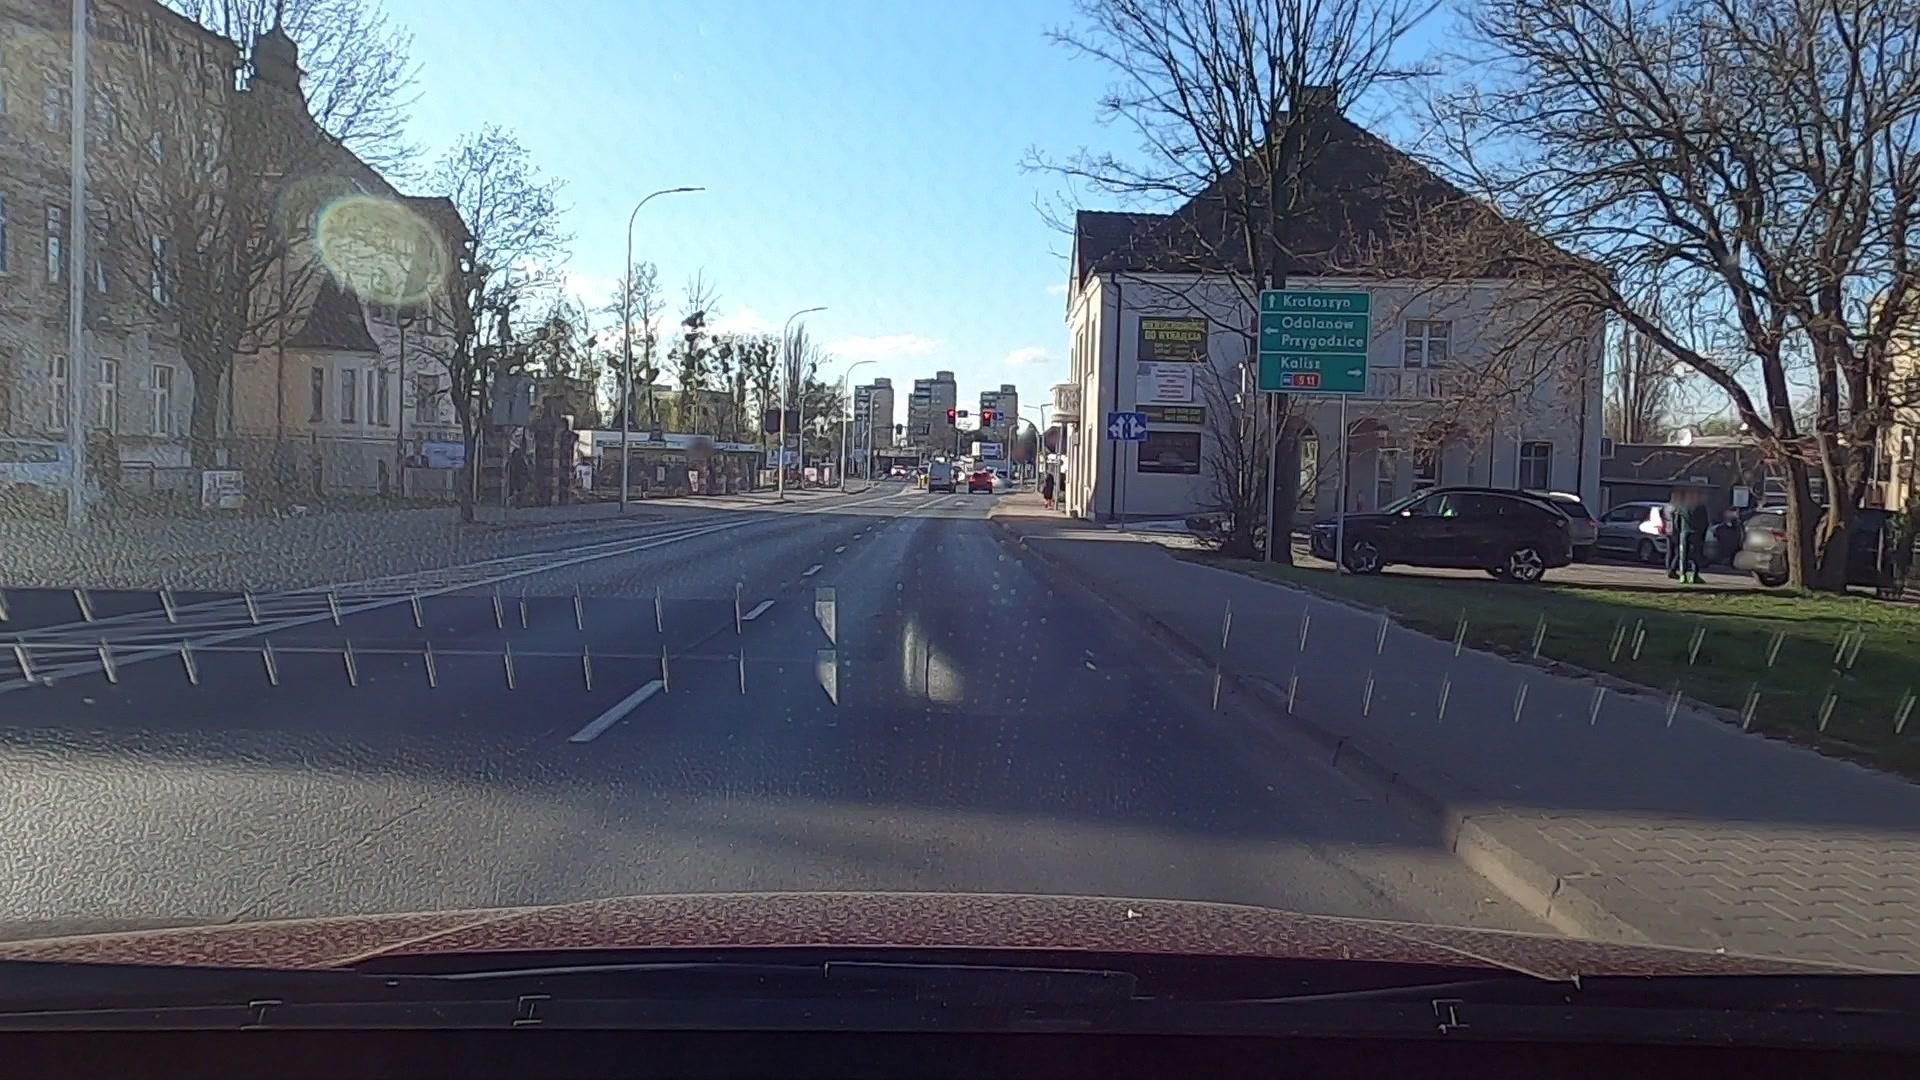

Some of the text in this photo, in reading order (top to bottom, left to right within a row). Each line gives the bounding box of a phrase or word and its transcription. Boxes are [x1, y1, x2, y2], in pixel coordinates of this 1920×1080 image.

[1283, 295, 1351, 310] Krotoszyn
[1281, 334, 1364, 349] Przygodzice
[1281, 357, 1320, 369] Kalisz
